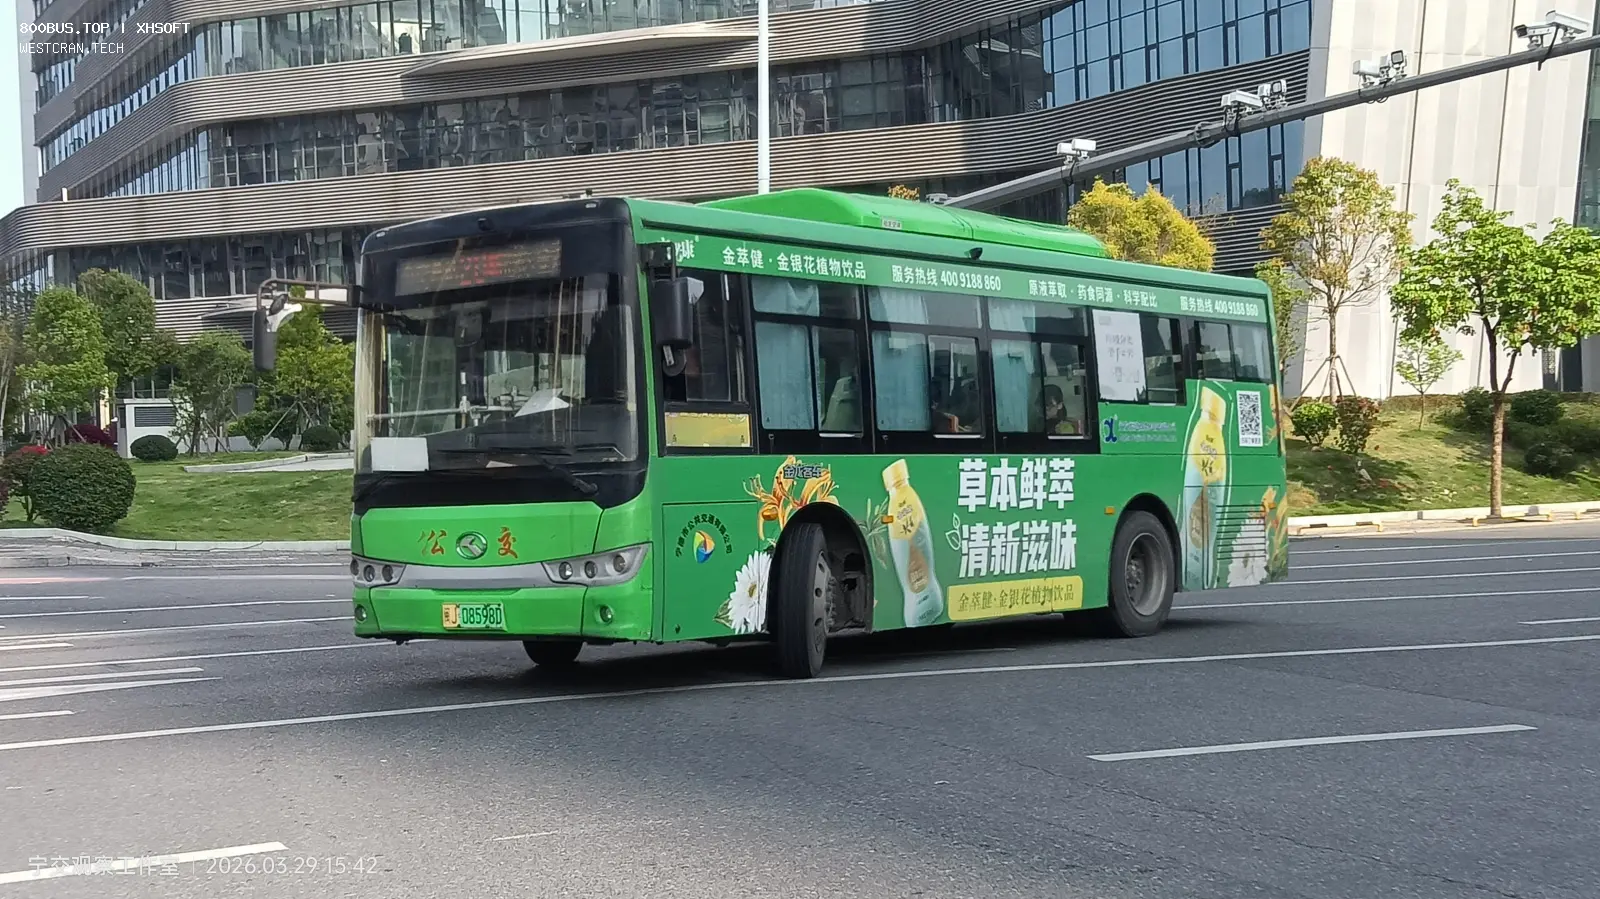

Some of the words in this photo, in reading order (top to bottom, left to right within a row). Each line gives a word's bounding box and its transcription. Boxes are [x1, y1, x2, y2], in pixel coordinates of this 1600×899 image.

[892, 264, 938, 287] 服务热线
[940, 270, 958, 287] 400
[959, 272, 983, 289] 9188
[984, 275, 1001, 291] 860
[1180, 295, 1213, 313] 服务热线
[957, 457, 1075, 513] 草本鲜萃
[958, 518, 1077, 579] 清新滋味
